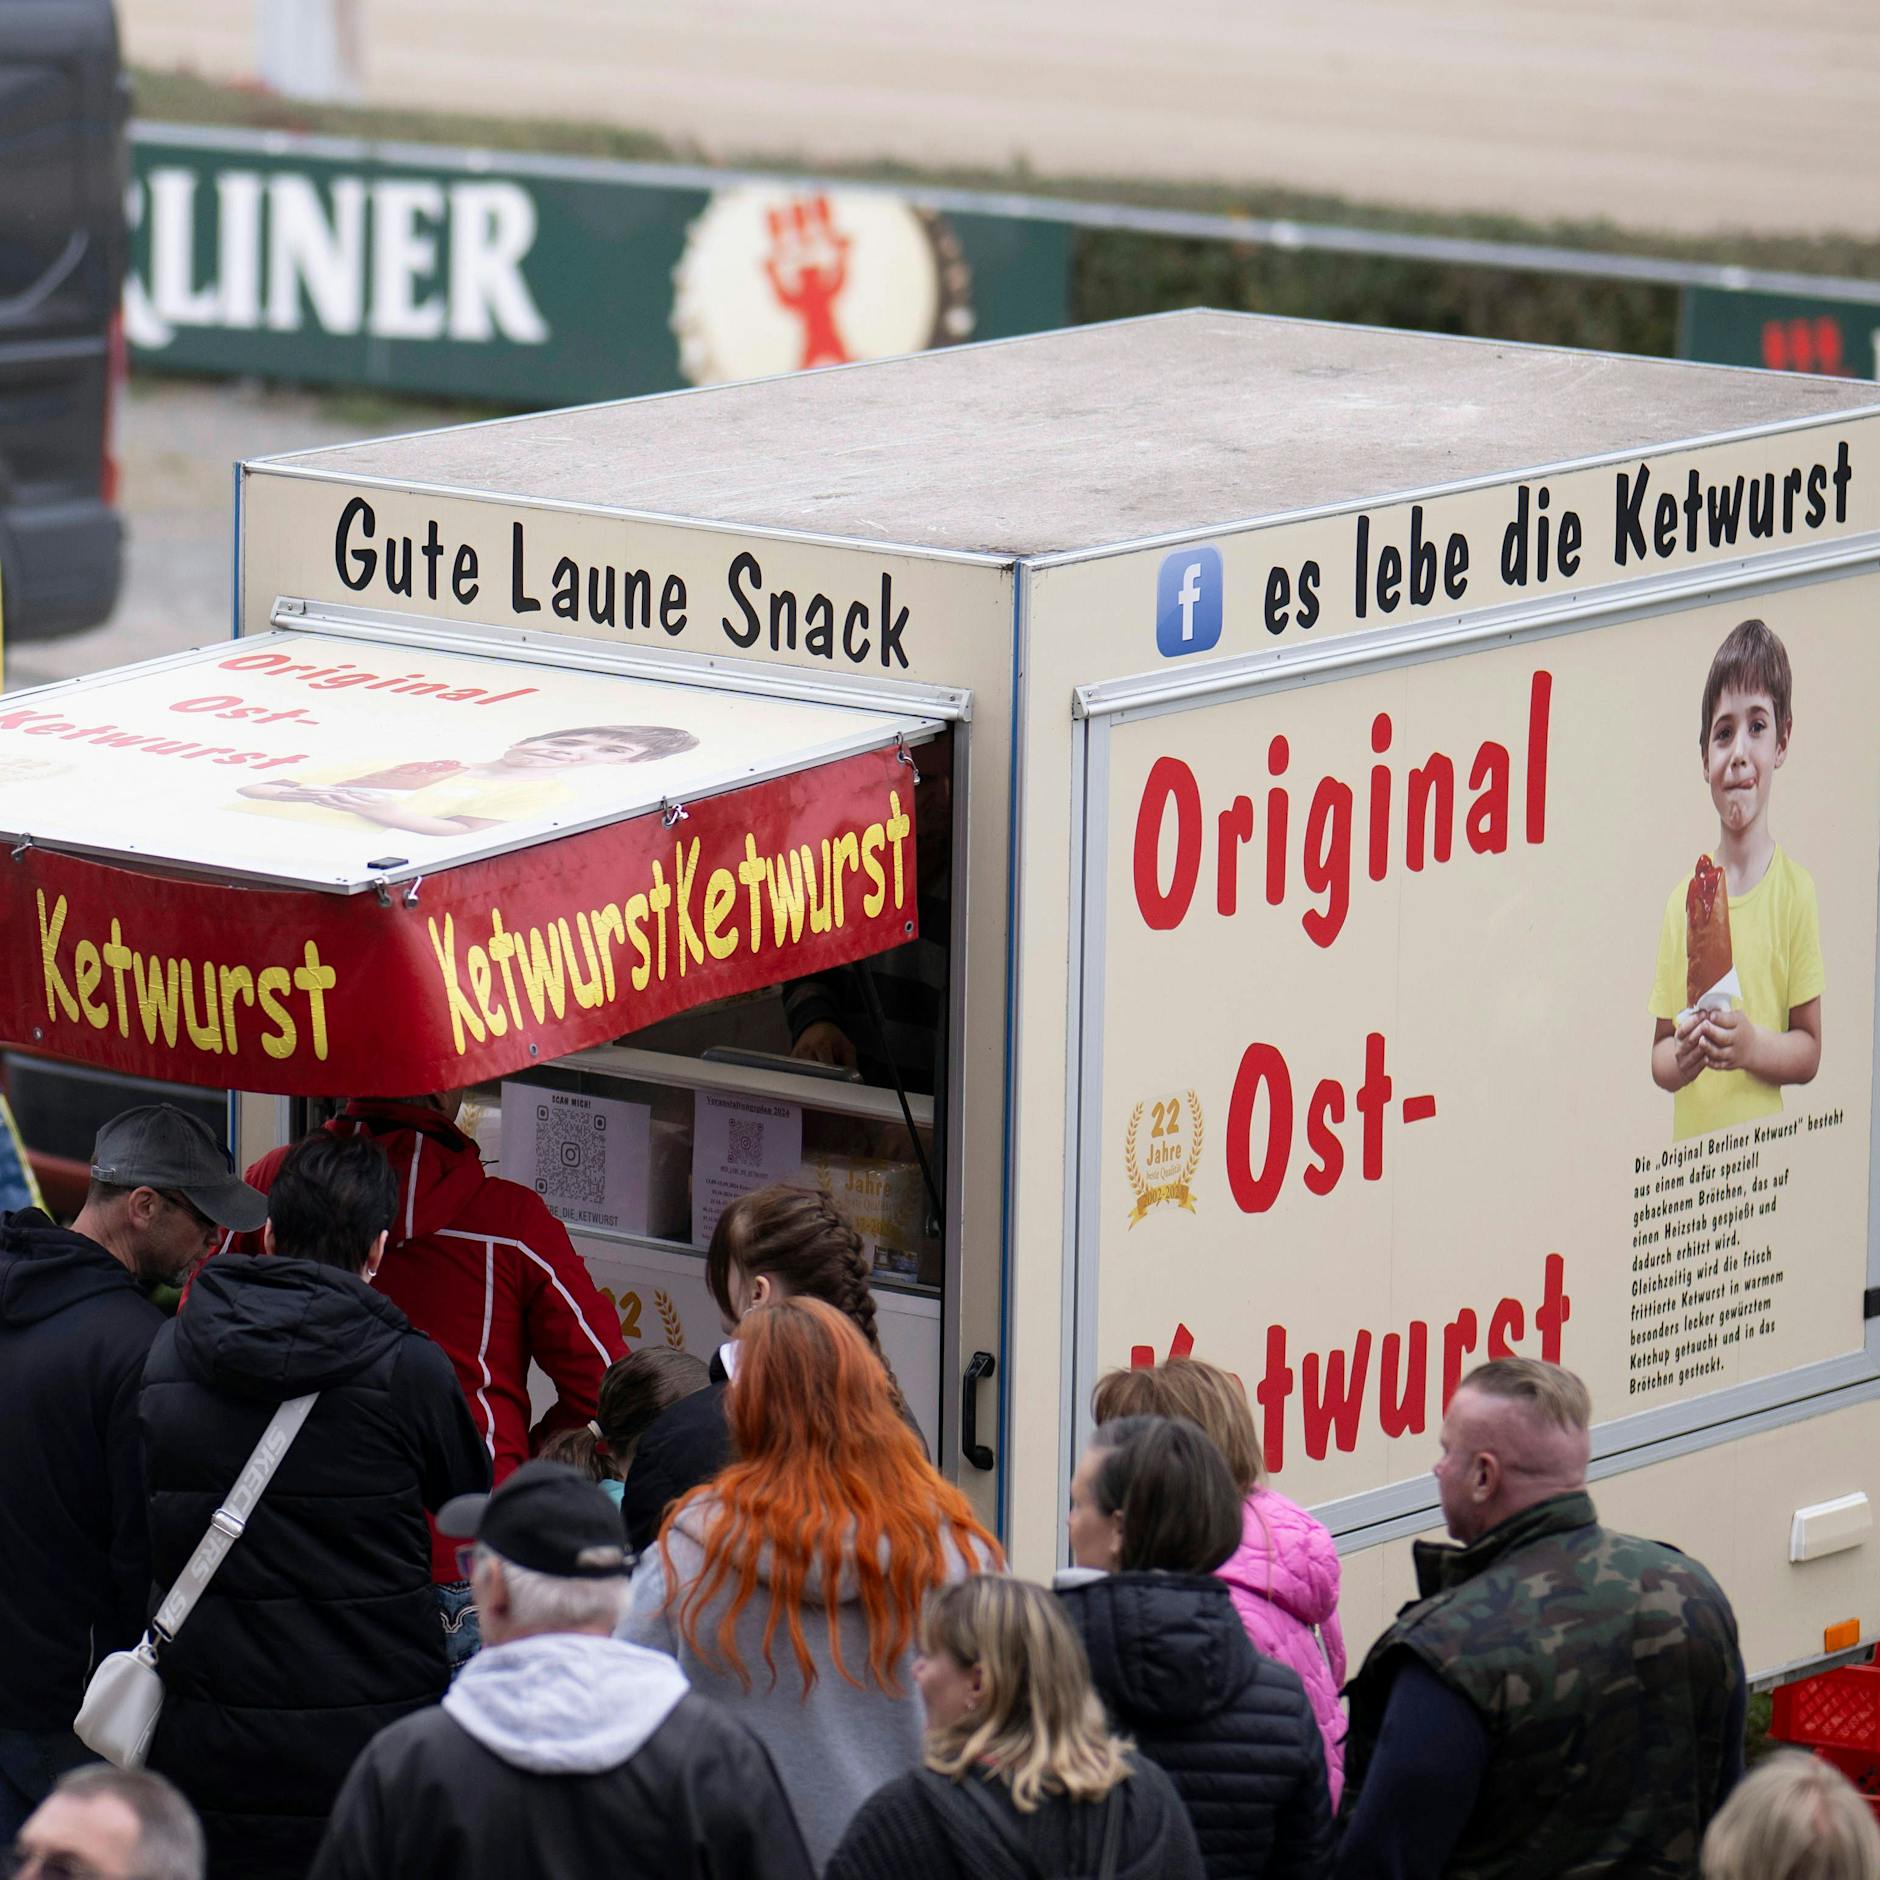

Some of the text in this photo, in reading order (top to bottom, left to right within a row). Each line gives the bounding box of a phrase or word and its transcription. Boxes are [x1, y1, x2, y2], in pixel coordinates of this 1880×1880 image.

[1264, 441, 1852, 636] es lebe die Ketwurst
[334, 496, 910, 669] Gute Laune Snack
[216, 653, 540, 706] Original
[168, 695, 321, 727] Ost-
[1, 709, 311, 770] Ketwurst
[1132, 669, 1553, 949] Original
[36, 888, 336, 1061] Ketwurst
[551, 1094, 569, 1107] SCAN
[1151, 1098, 1181, 1138] 22
[1225, 1032, 1437, 1214] Ost-
[1146, 1141, 1183, 1166] Jahre
[1634, 1156, 1651, 1174] Die
[1708, 1134, 1750, 1156] Berliner
[1807, 1108, 1844, 1132] besteht
[844, 1169, 892, 1197] Jahre
[1633, 1151, 1759, 1199] aus einem dafür speziell
[1633, 1167, 1790, 1229] gebackenem Brötchen, das auf
[549, 1204, 619, 1228] BE_DIE_KETWURST
[1632, 1195, 1777, 1248] einen Heizstab gespießt und
[1631, 1245, 1772, 1297] Gleichzeitig wird die frisch
[1632, 1229, 1740, 1272] dadurch erhitzt wird.
[1630, 1271, 1784, 1322] frittierte Ketwurst in warmem
[1630, 1298, 1771, 1346] besonders lecker gewürztem
[1130, 1253, 1571, 1474] twurst
[1629, 1317, 1776, 1371] Ketchup getaucht und in das
[1629, 1355, 1724, 1395] Brötchen gesteckt.
[190, 1423, 288, 1585] SKECERS
